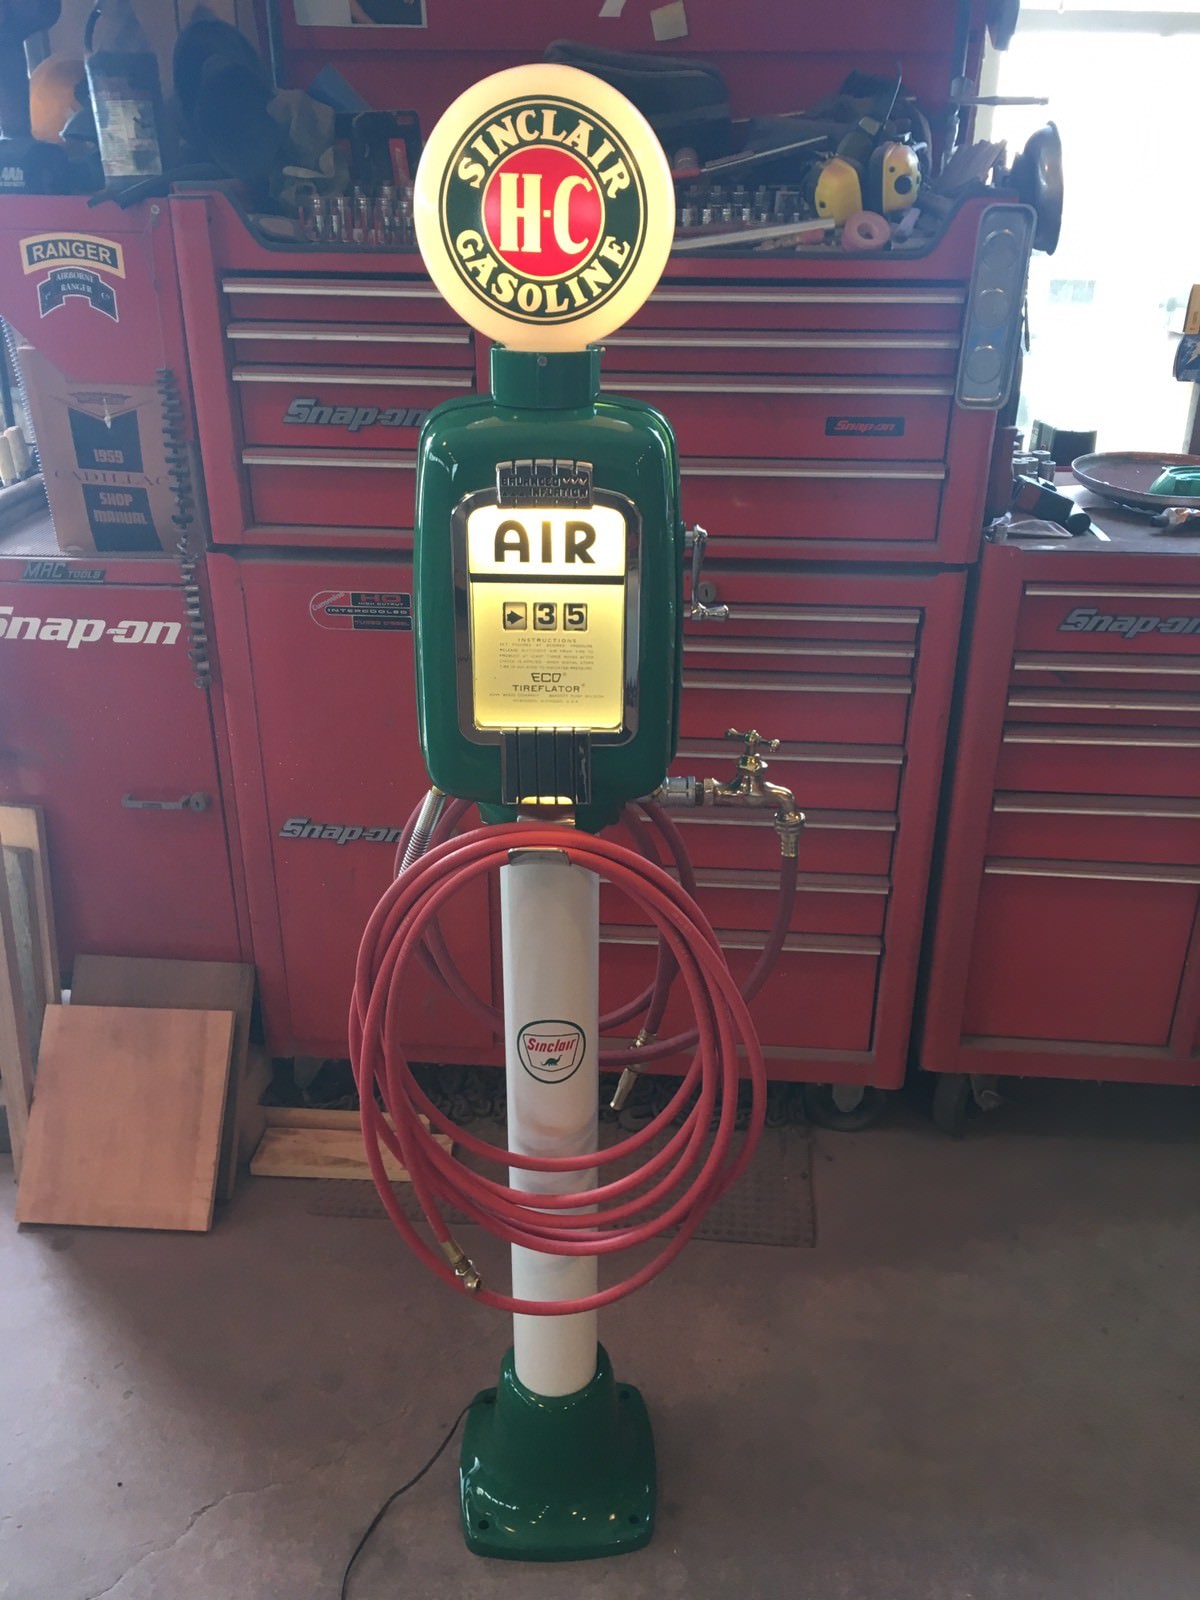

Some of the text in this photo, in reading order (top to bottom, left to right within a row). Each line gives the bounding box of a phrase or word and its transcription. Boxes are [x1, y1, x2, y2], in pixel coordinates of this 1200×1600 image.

[458, 109, 631, 199] SINCLAIR
[32, 242, 113, 265] RANGER
[456, 229, 631, 313] GASOLINE
[60, 283, 93, 293] RANGER
[283, 397, 423, 432] Snap-on
[833, 419, 897, 433] Snap-on
[93, 449, 124, 464] 1959
[99, 492, 133, 506] SHOP
[93, 509, 149, 525] MANUAL
[494, 519, 596, 564] AIR
[24, 562, 101, 579] MAC TOOLS
[1058, 606, 1200, 639] Snap-on
[512, 684, 581, 693] TIREFLATOR
[279, 817, 402, 845] Snap-on
[527, 1037, 577, 1053] Sinclair
